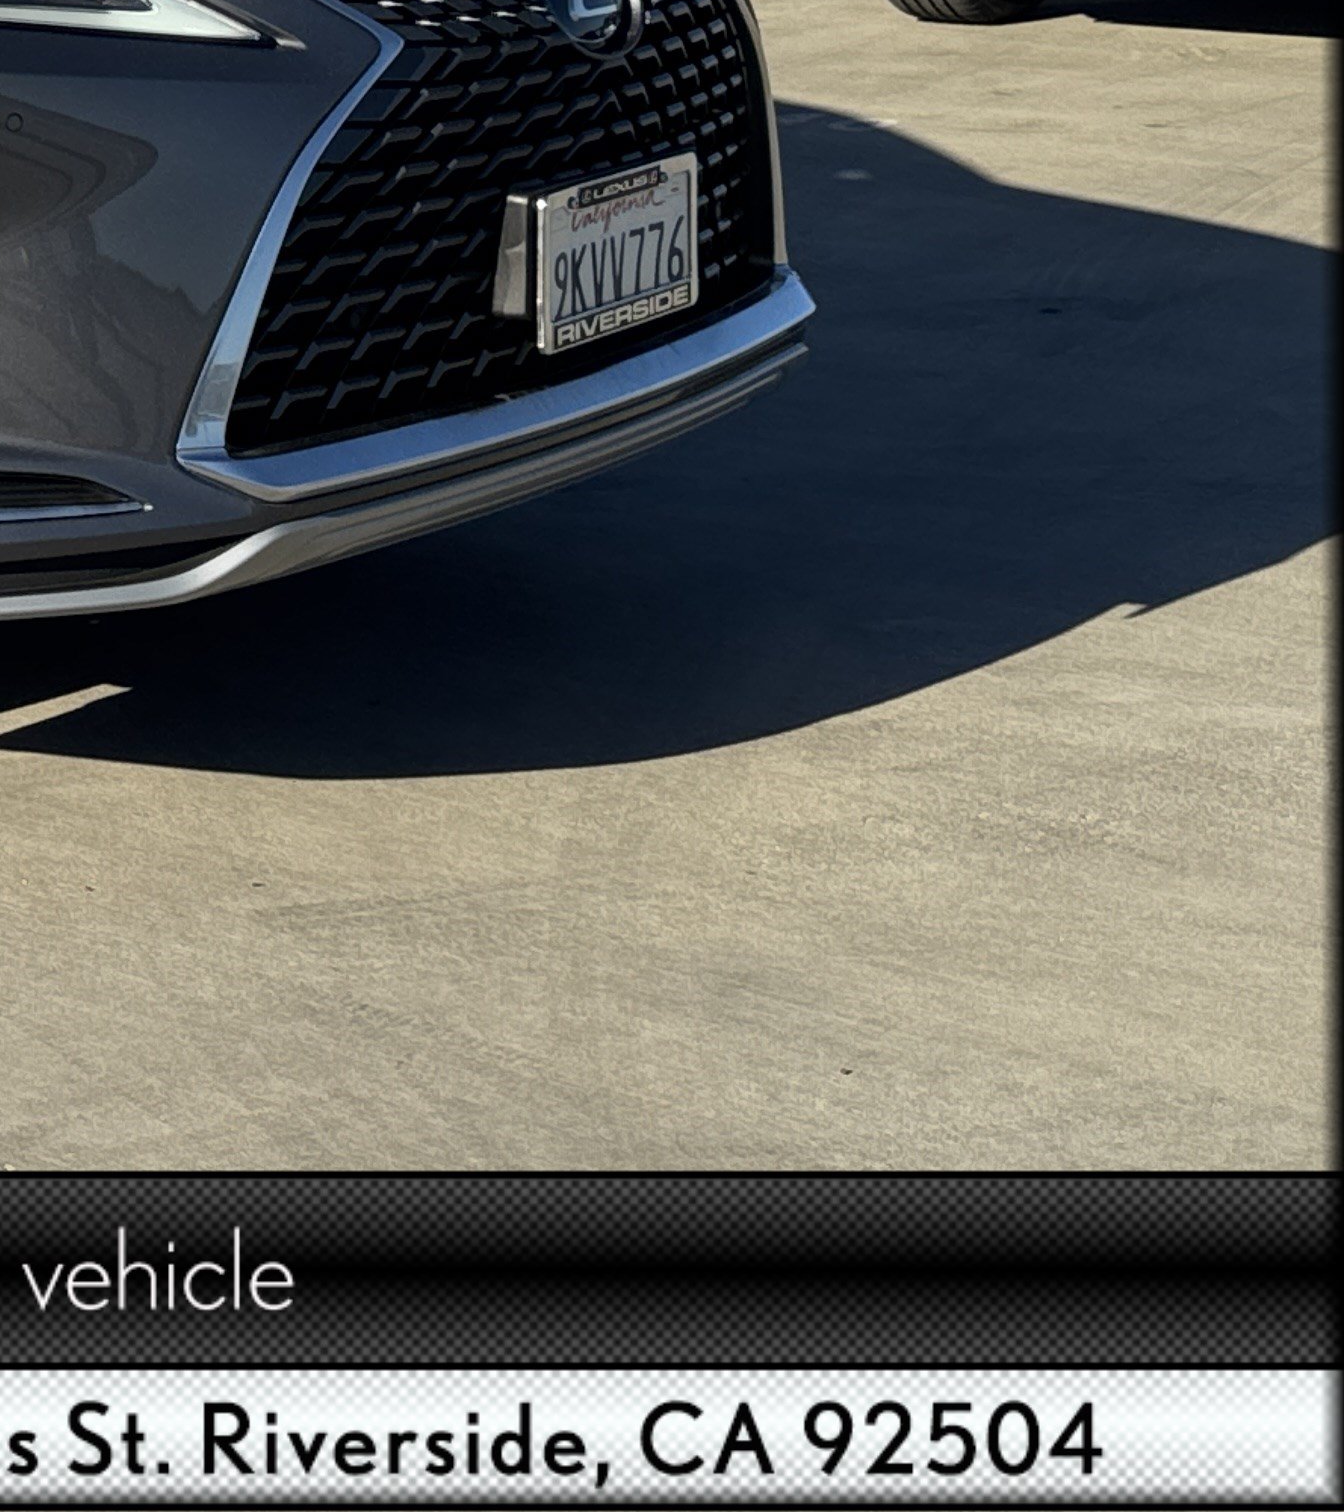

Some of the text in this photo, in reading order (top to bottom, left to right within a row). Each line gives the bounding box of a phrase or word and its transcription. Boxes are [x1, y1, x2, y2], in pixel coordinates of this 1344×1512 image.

[593, 175, 648, 199] LEXUS
[555, 215, 684, 321] 9KVV776
[557, 289, 689, 346] RIVERSIDE
